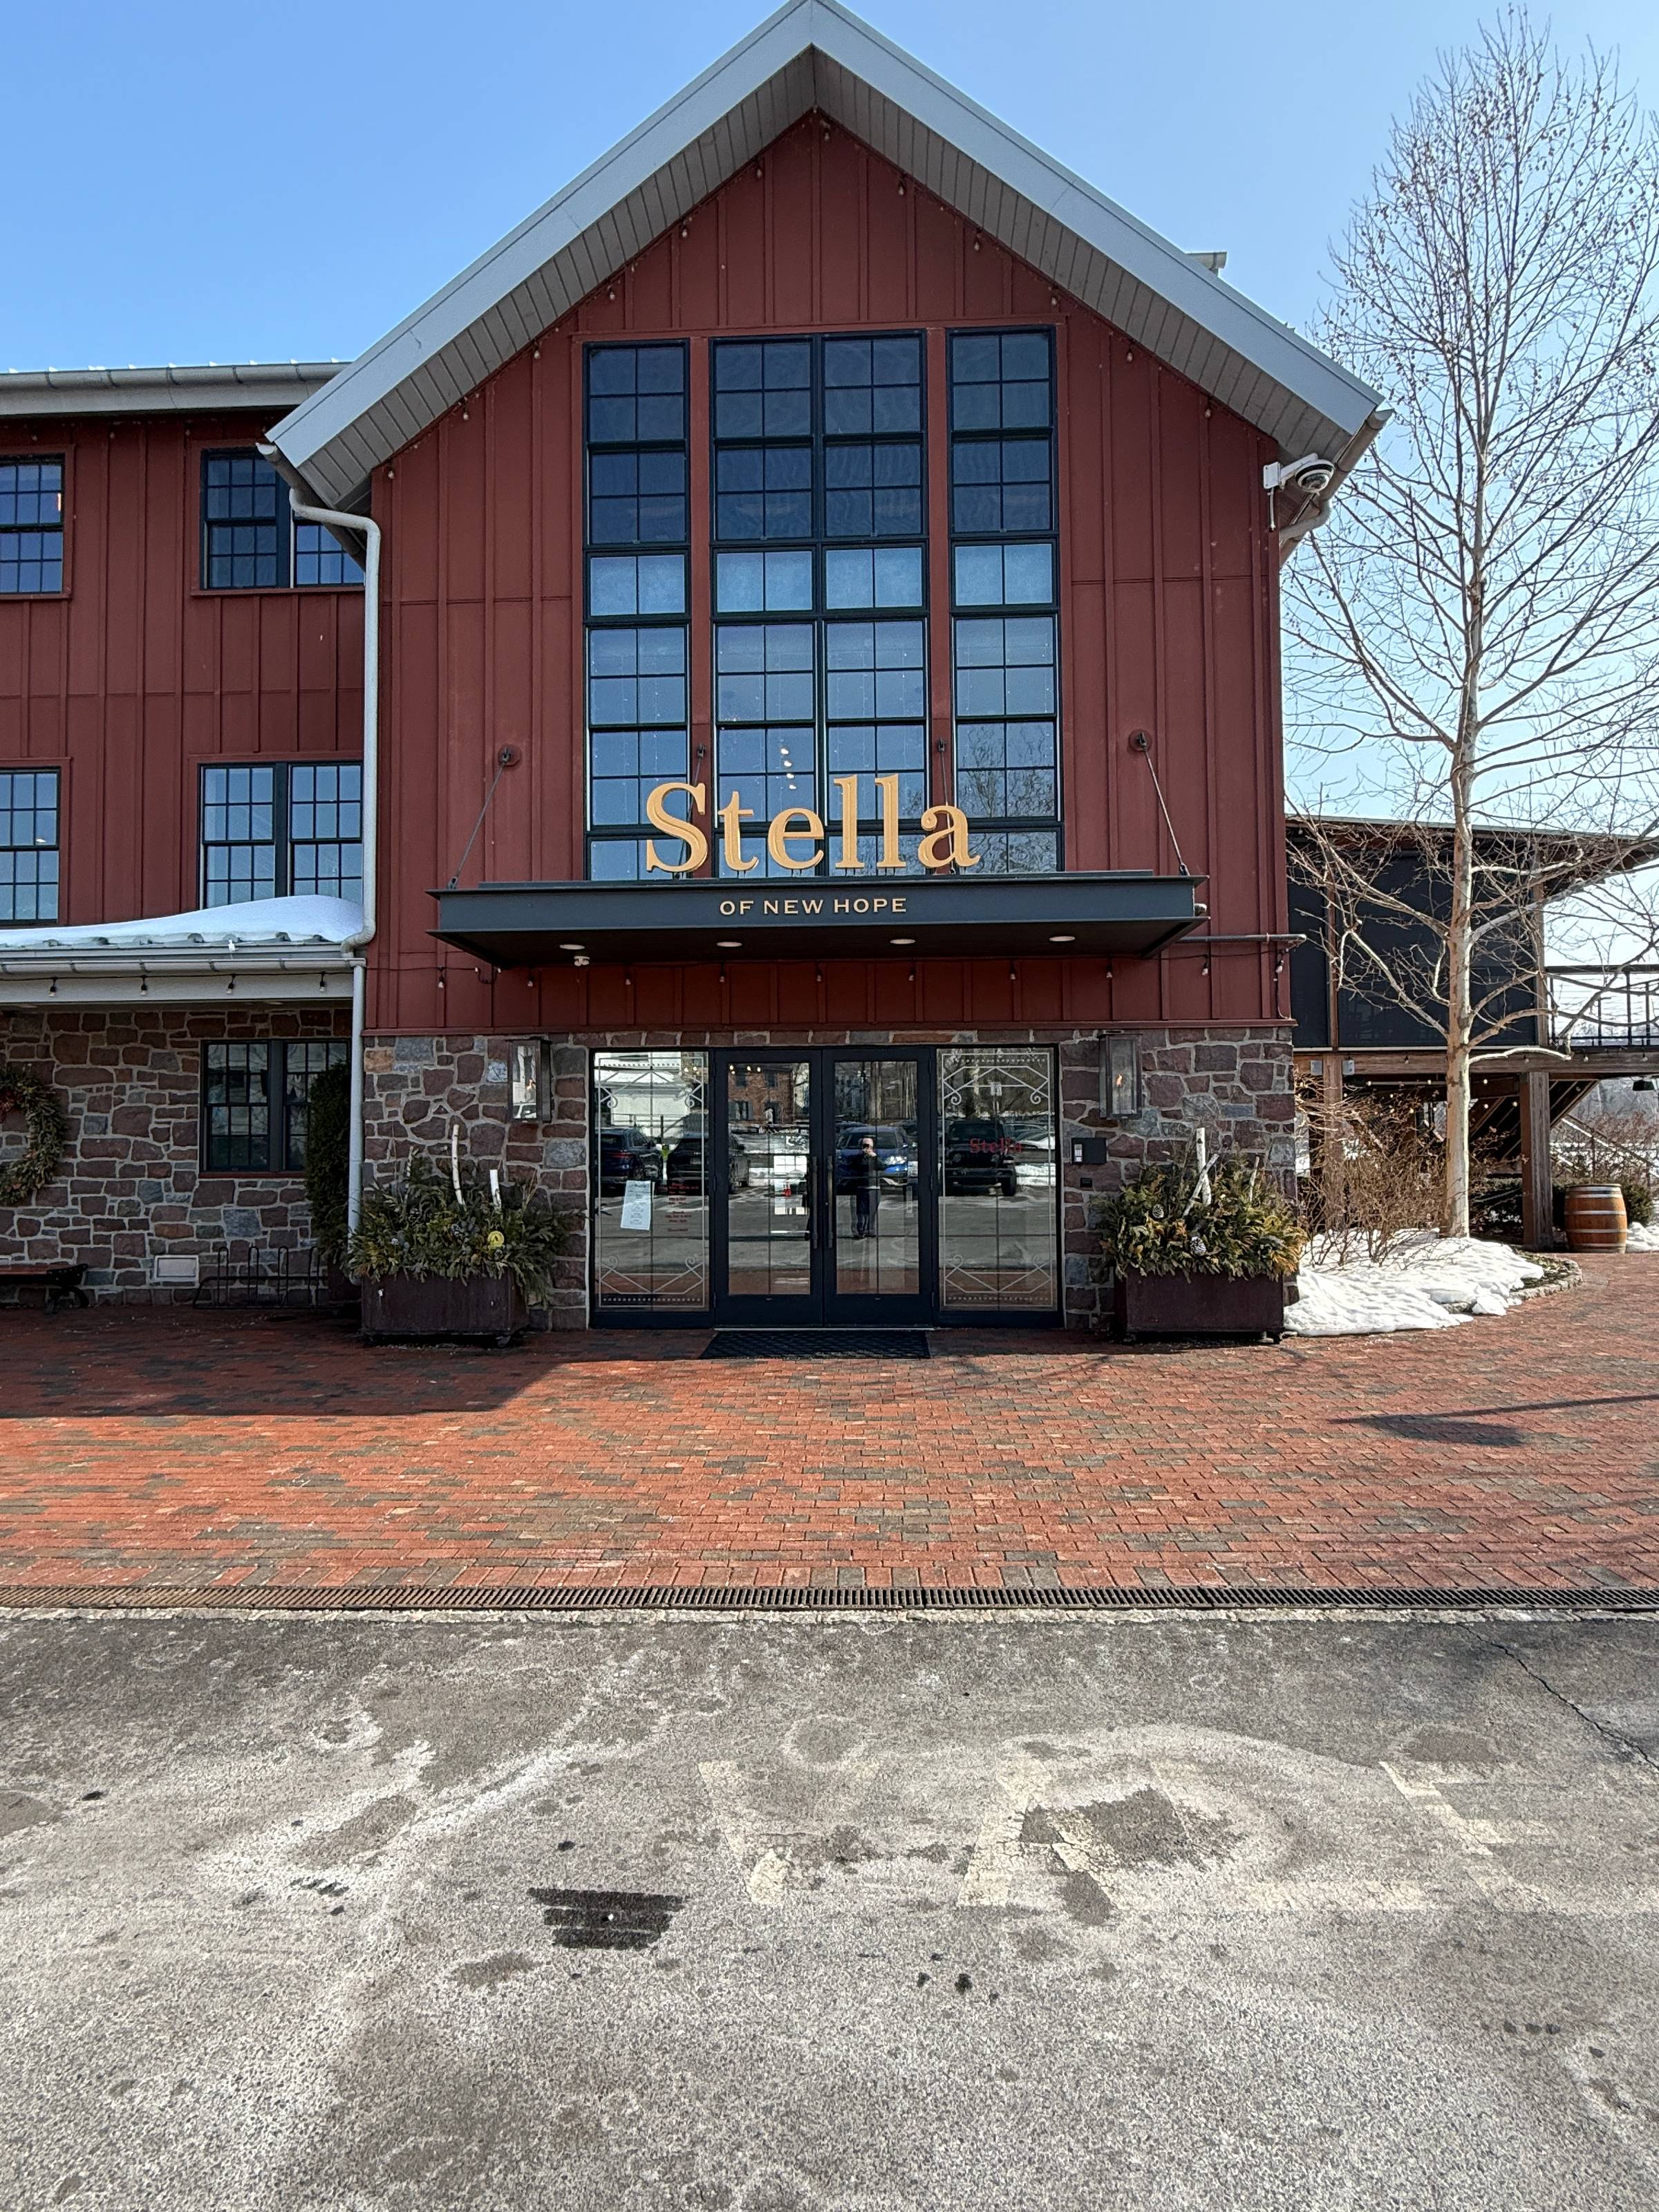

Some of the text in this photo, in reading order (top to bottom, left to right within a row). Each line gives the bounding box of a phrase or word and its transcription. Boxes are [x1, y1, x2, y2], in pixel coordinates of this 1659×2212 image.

[646, 774, 980, 872] Stella
[720, 898, 907, 915] OF NEW HOPE
[969, 1136, 1023, 1154] Stella
